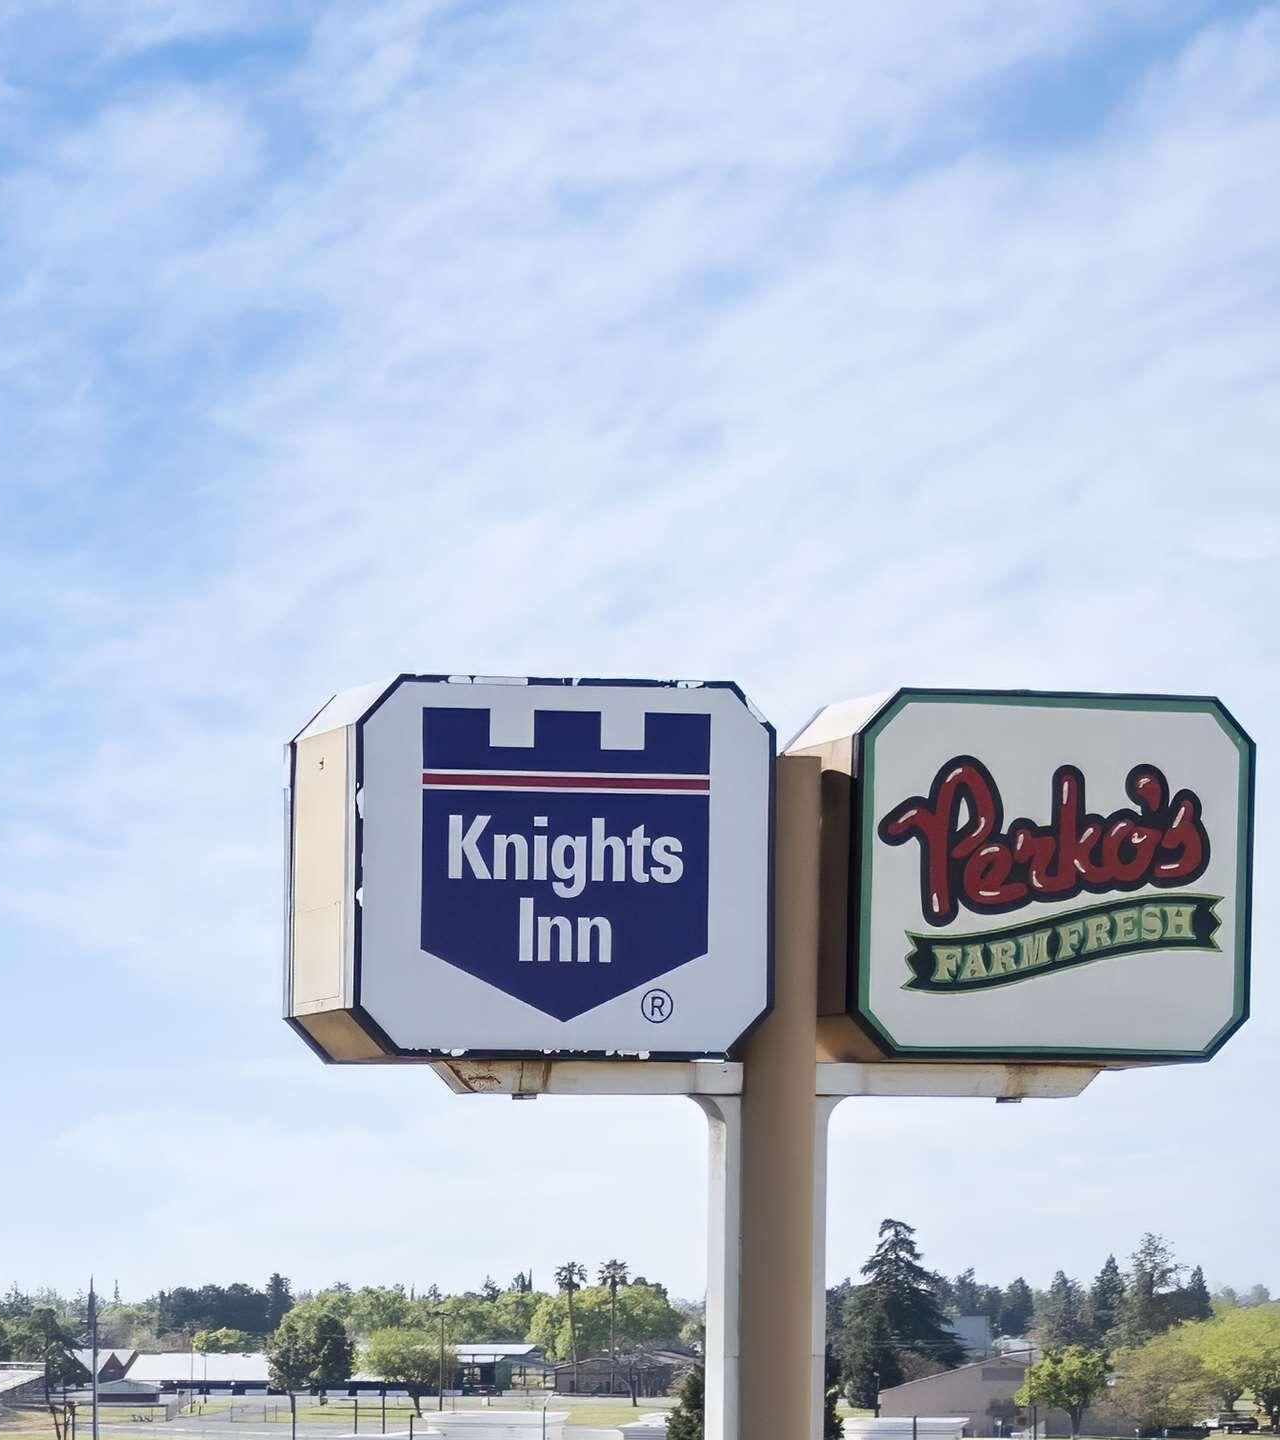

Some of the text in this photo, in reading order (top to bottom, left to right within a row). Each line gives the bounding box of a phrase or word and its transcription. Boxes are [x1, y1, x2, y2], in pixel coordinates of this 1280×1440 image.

[447, 814, 684, 899] Knights
[878, 755, 1211, 927] Perko's
[518, 897, 612, 963] Inn
[930, 902, 1200, 984] FARM FRESH
